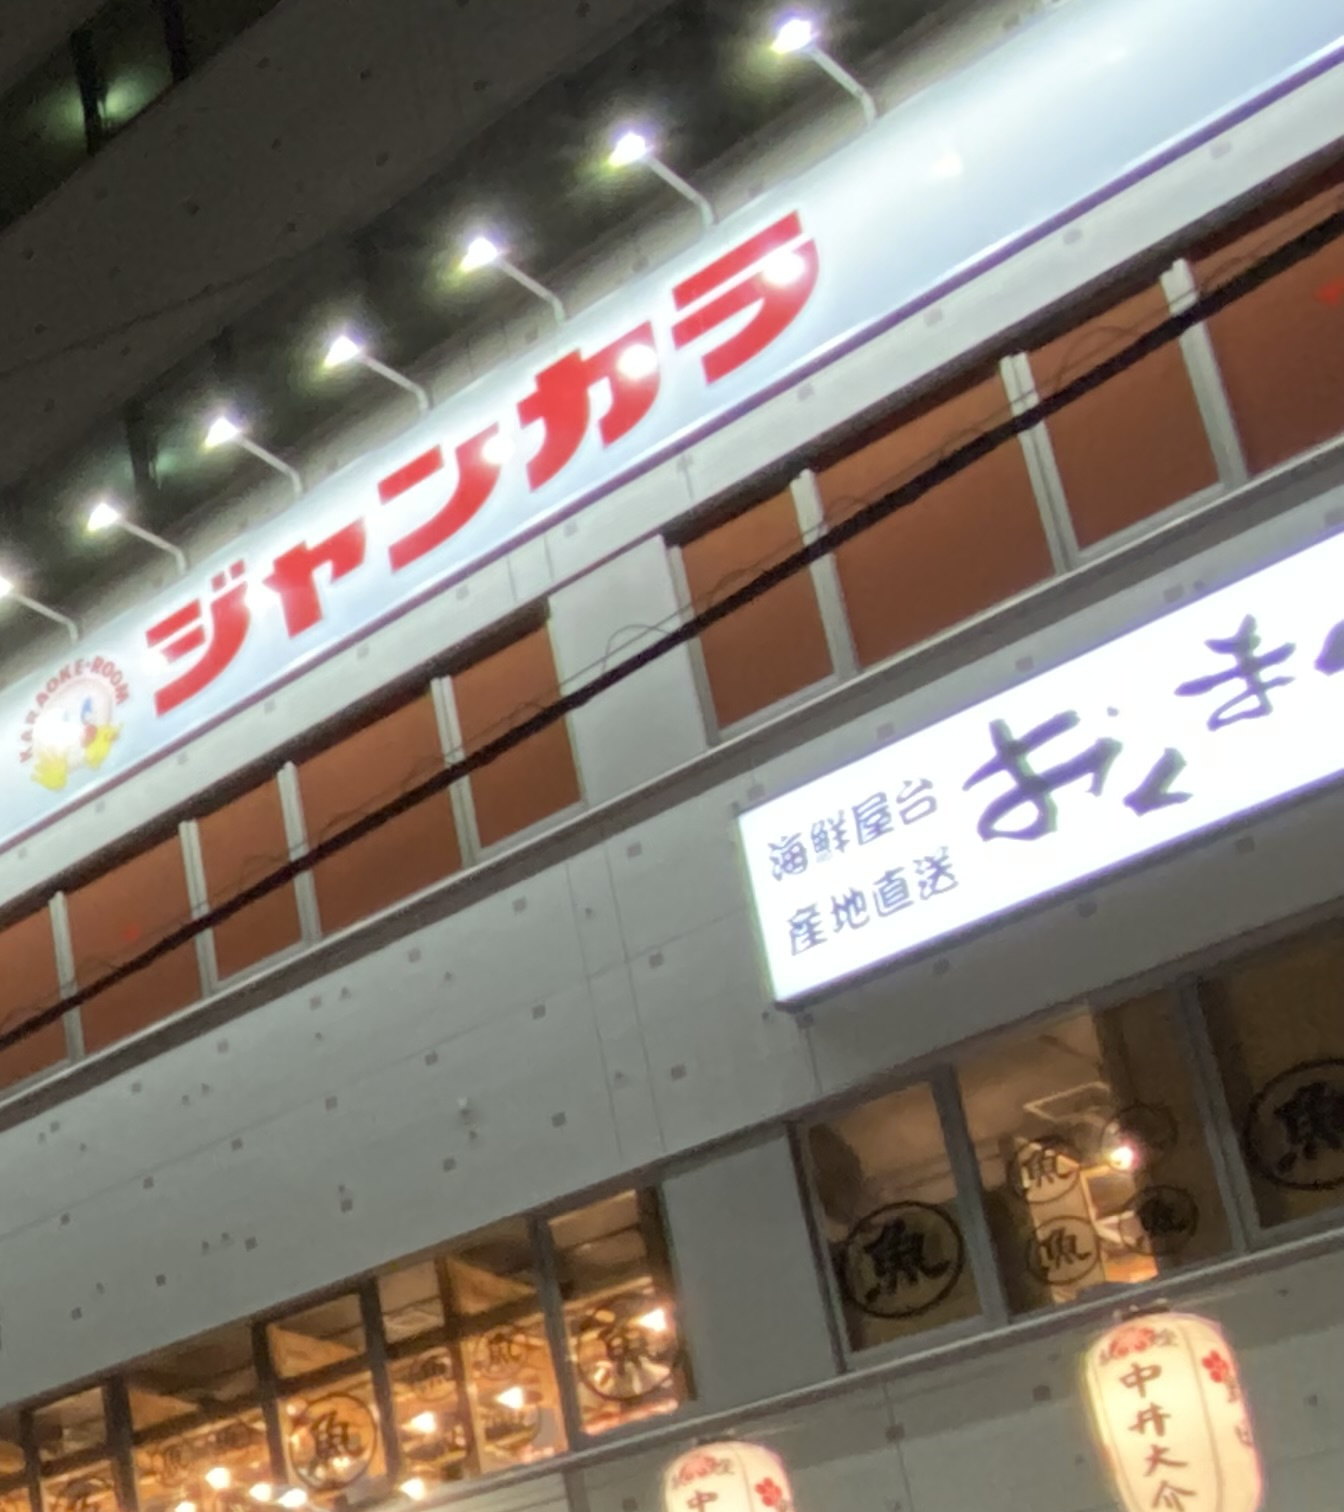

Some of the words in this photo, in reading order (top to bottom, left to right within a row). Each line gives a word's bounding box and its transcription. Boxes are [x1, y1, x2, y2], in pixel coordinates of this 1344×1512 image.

[143, 209, 820, 718] ジャンカラ
[767, 777, 939, 882] 海鮮屋台
[786, 846, 960, 956] 産地直送
